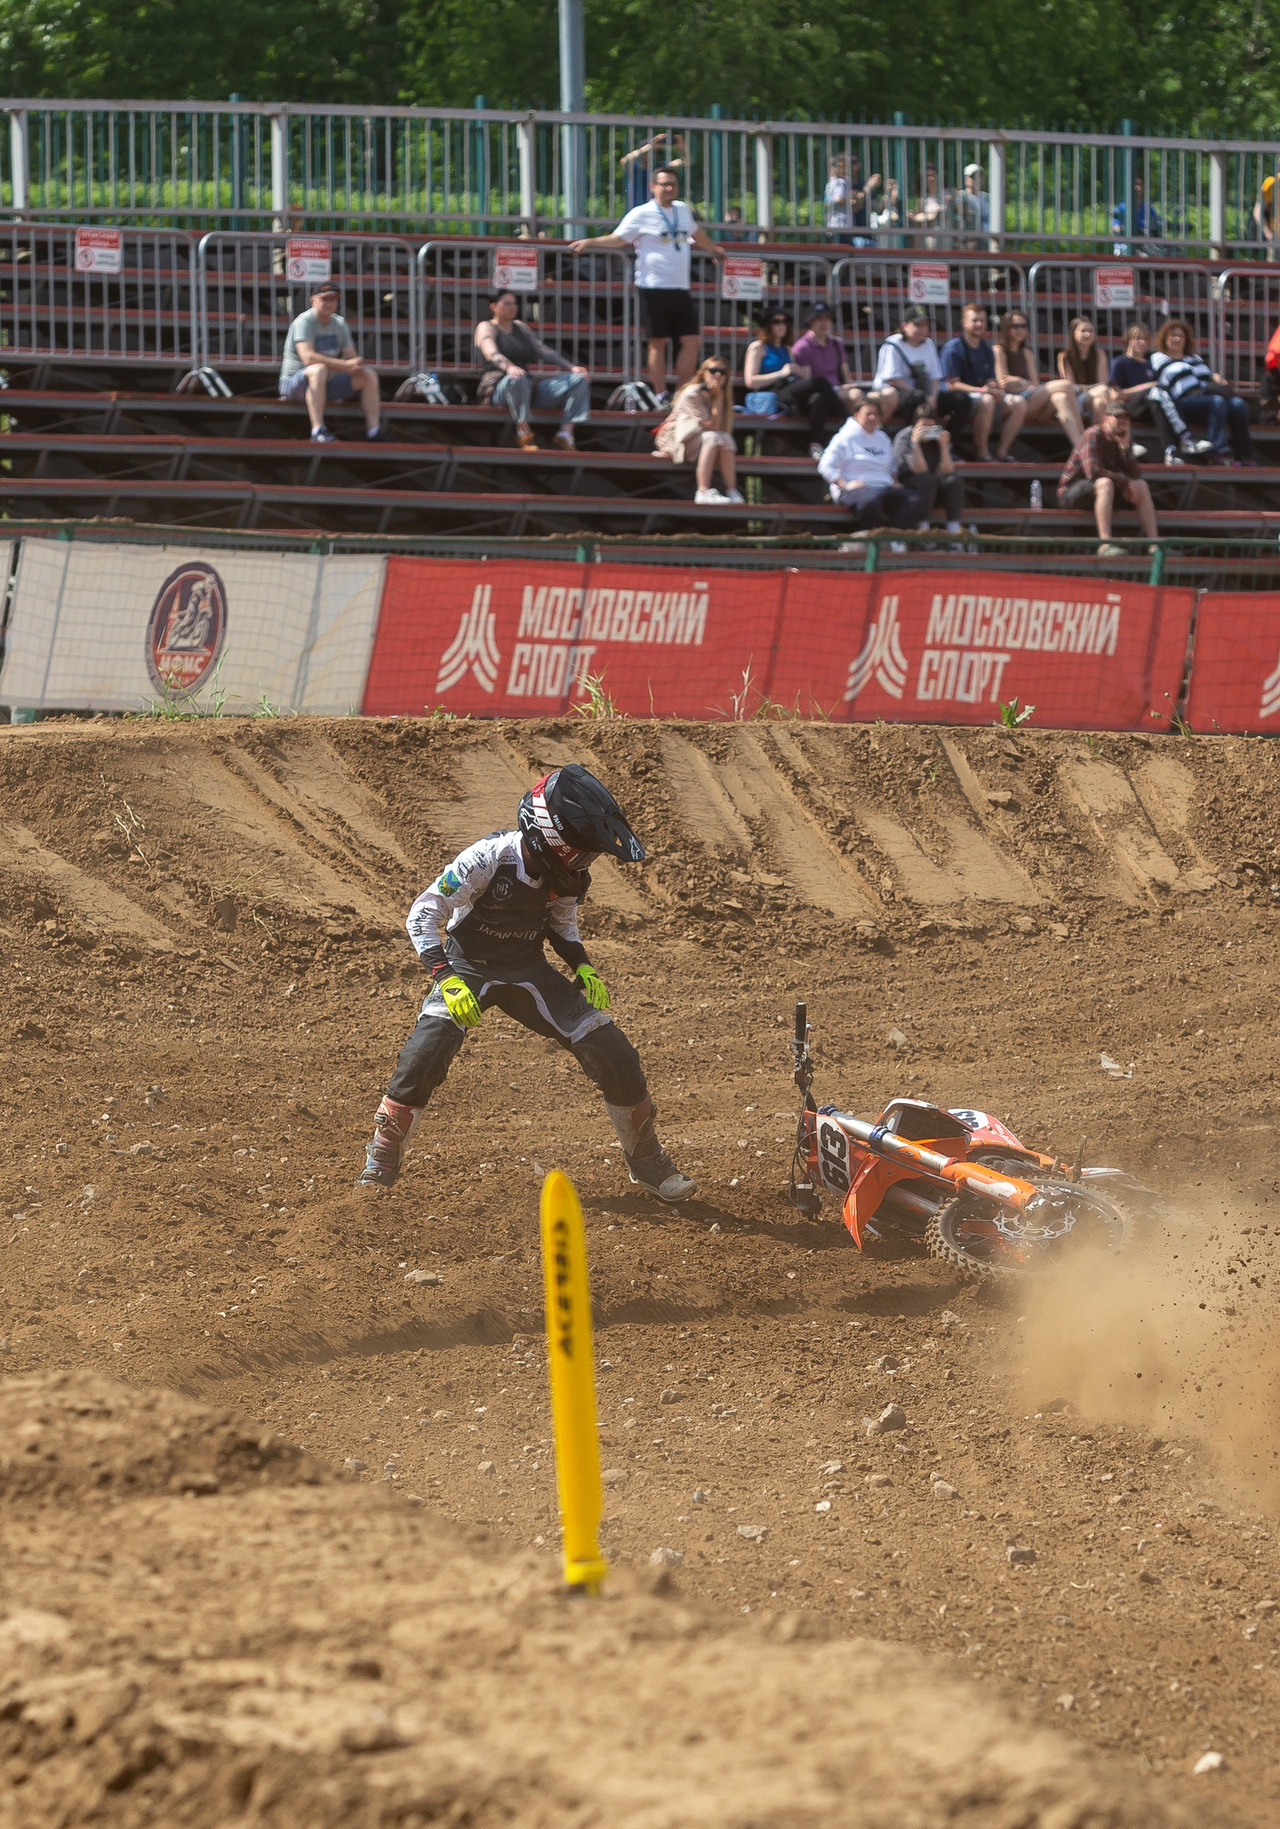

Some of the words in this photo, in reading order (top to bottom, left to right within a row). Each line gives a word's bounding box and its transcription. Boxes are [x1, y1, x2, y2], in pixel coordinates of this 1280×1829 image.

[517, 582, 710, 645] МОСКОВСКИЙ
[925, 593, 1121, 656] МОСКОВСКИЙ
[506, 643, 598, 697] СПОРТ
[915, 650, 1012, 703] СПОРТ
[819, 1120, 850, 1192] 613
